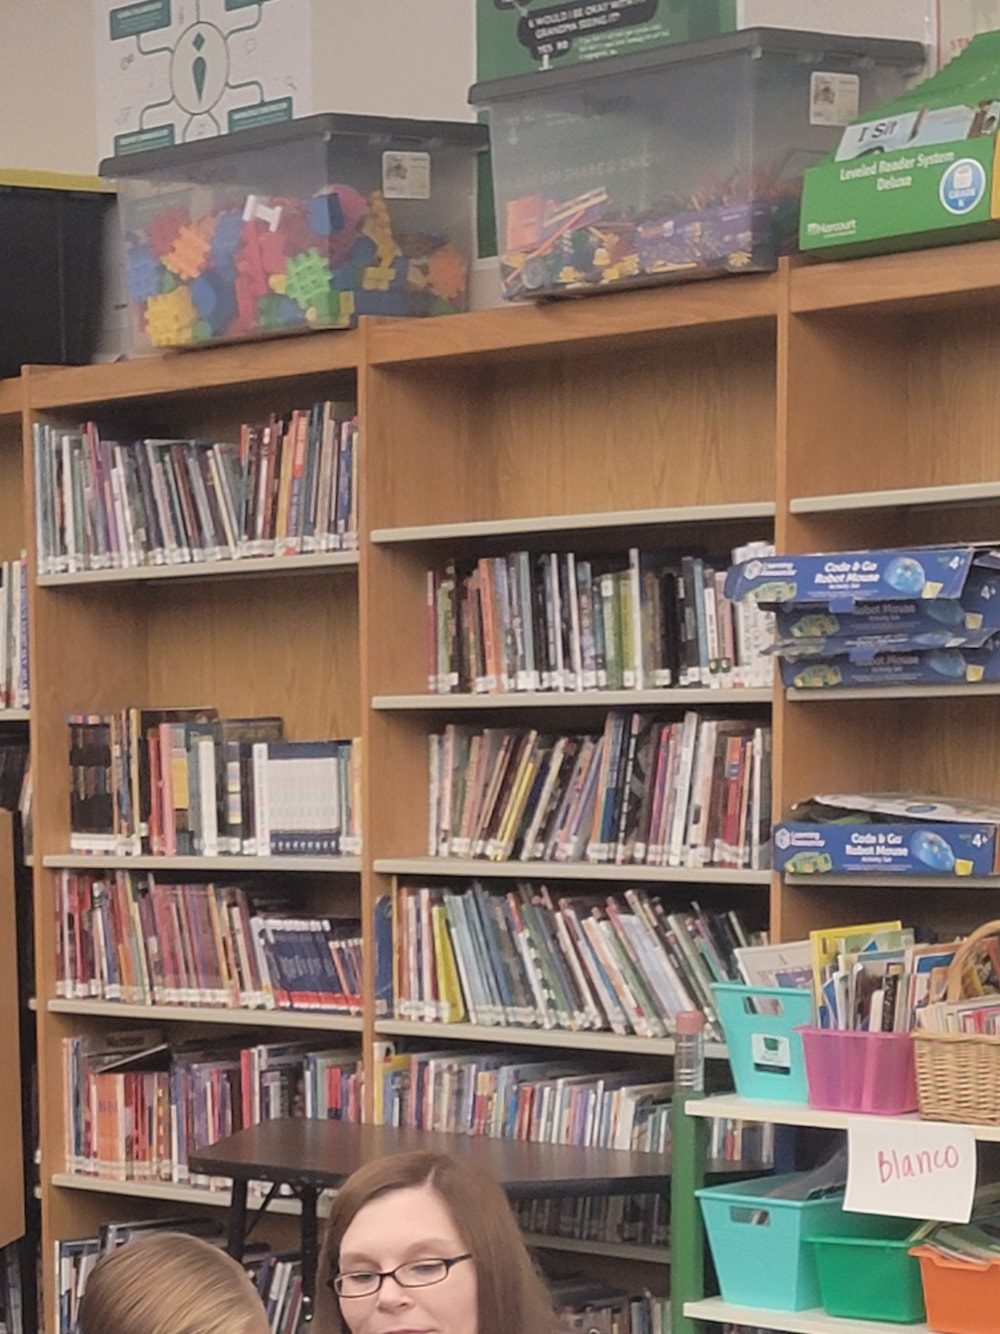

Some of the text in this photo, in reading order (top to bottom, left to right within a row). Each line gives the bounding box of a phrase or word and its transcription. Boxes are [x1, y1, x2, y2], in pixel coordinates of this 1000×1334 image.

[839, 151, 955, 181] Leveled Reader System
[876, 175, 912, 191] Deluxe
[823, 561, 852, 573] Code
[861, 560, 879, 572] Go
[814, 571, 881, 584] Robot Mouse
[850, 832, 877, 845] Code
[886, 832, 903, 845] Go
[845, 844, 909, 857] Robot Mouse
